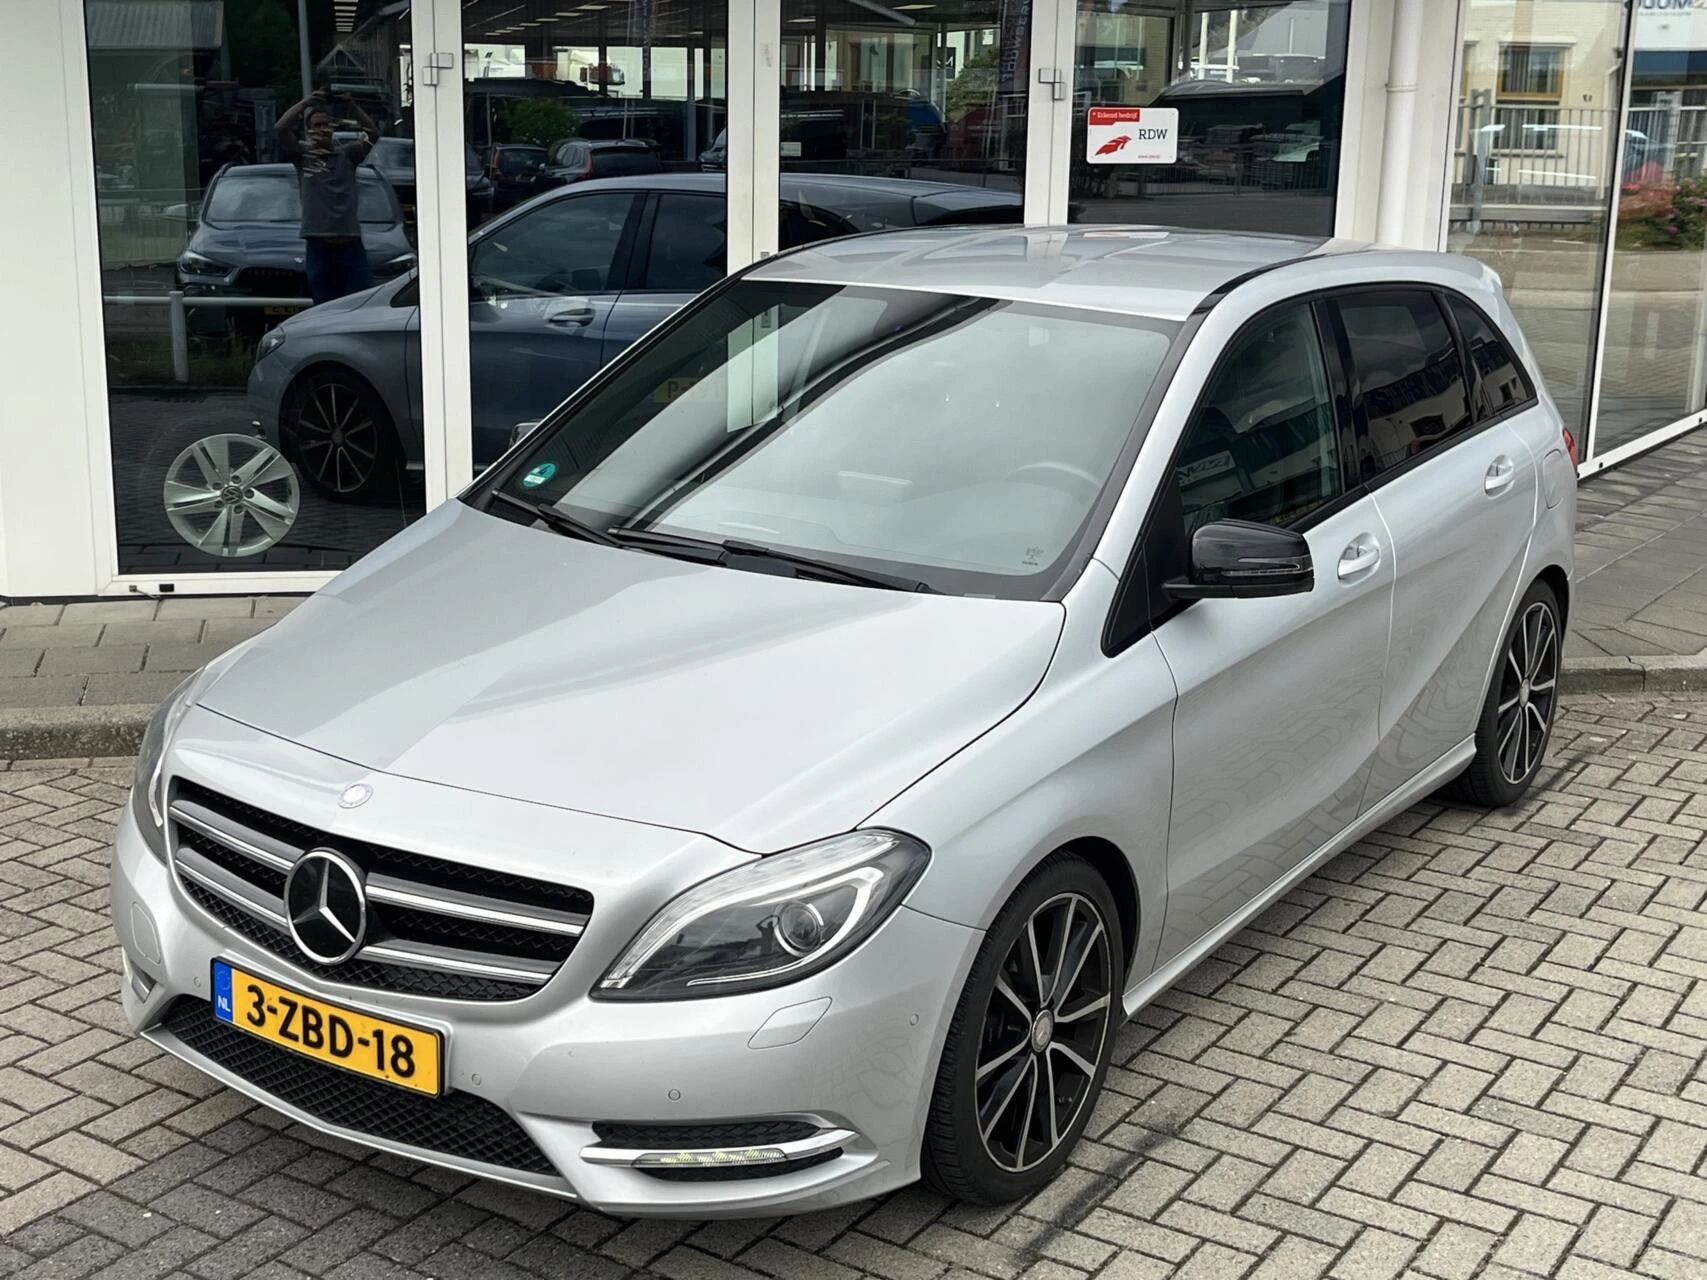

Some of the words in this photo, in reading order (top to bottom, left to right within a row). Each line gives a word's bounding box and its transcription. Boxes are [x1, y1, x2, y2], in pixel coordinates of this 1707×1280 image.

[1138, 128, 1168, 140] RDW
[217, 995, 231, 1012] NL
[246, 984, 416, 1078] 3-ZBD-18
